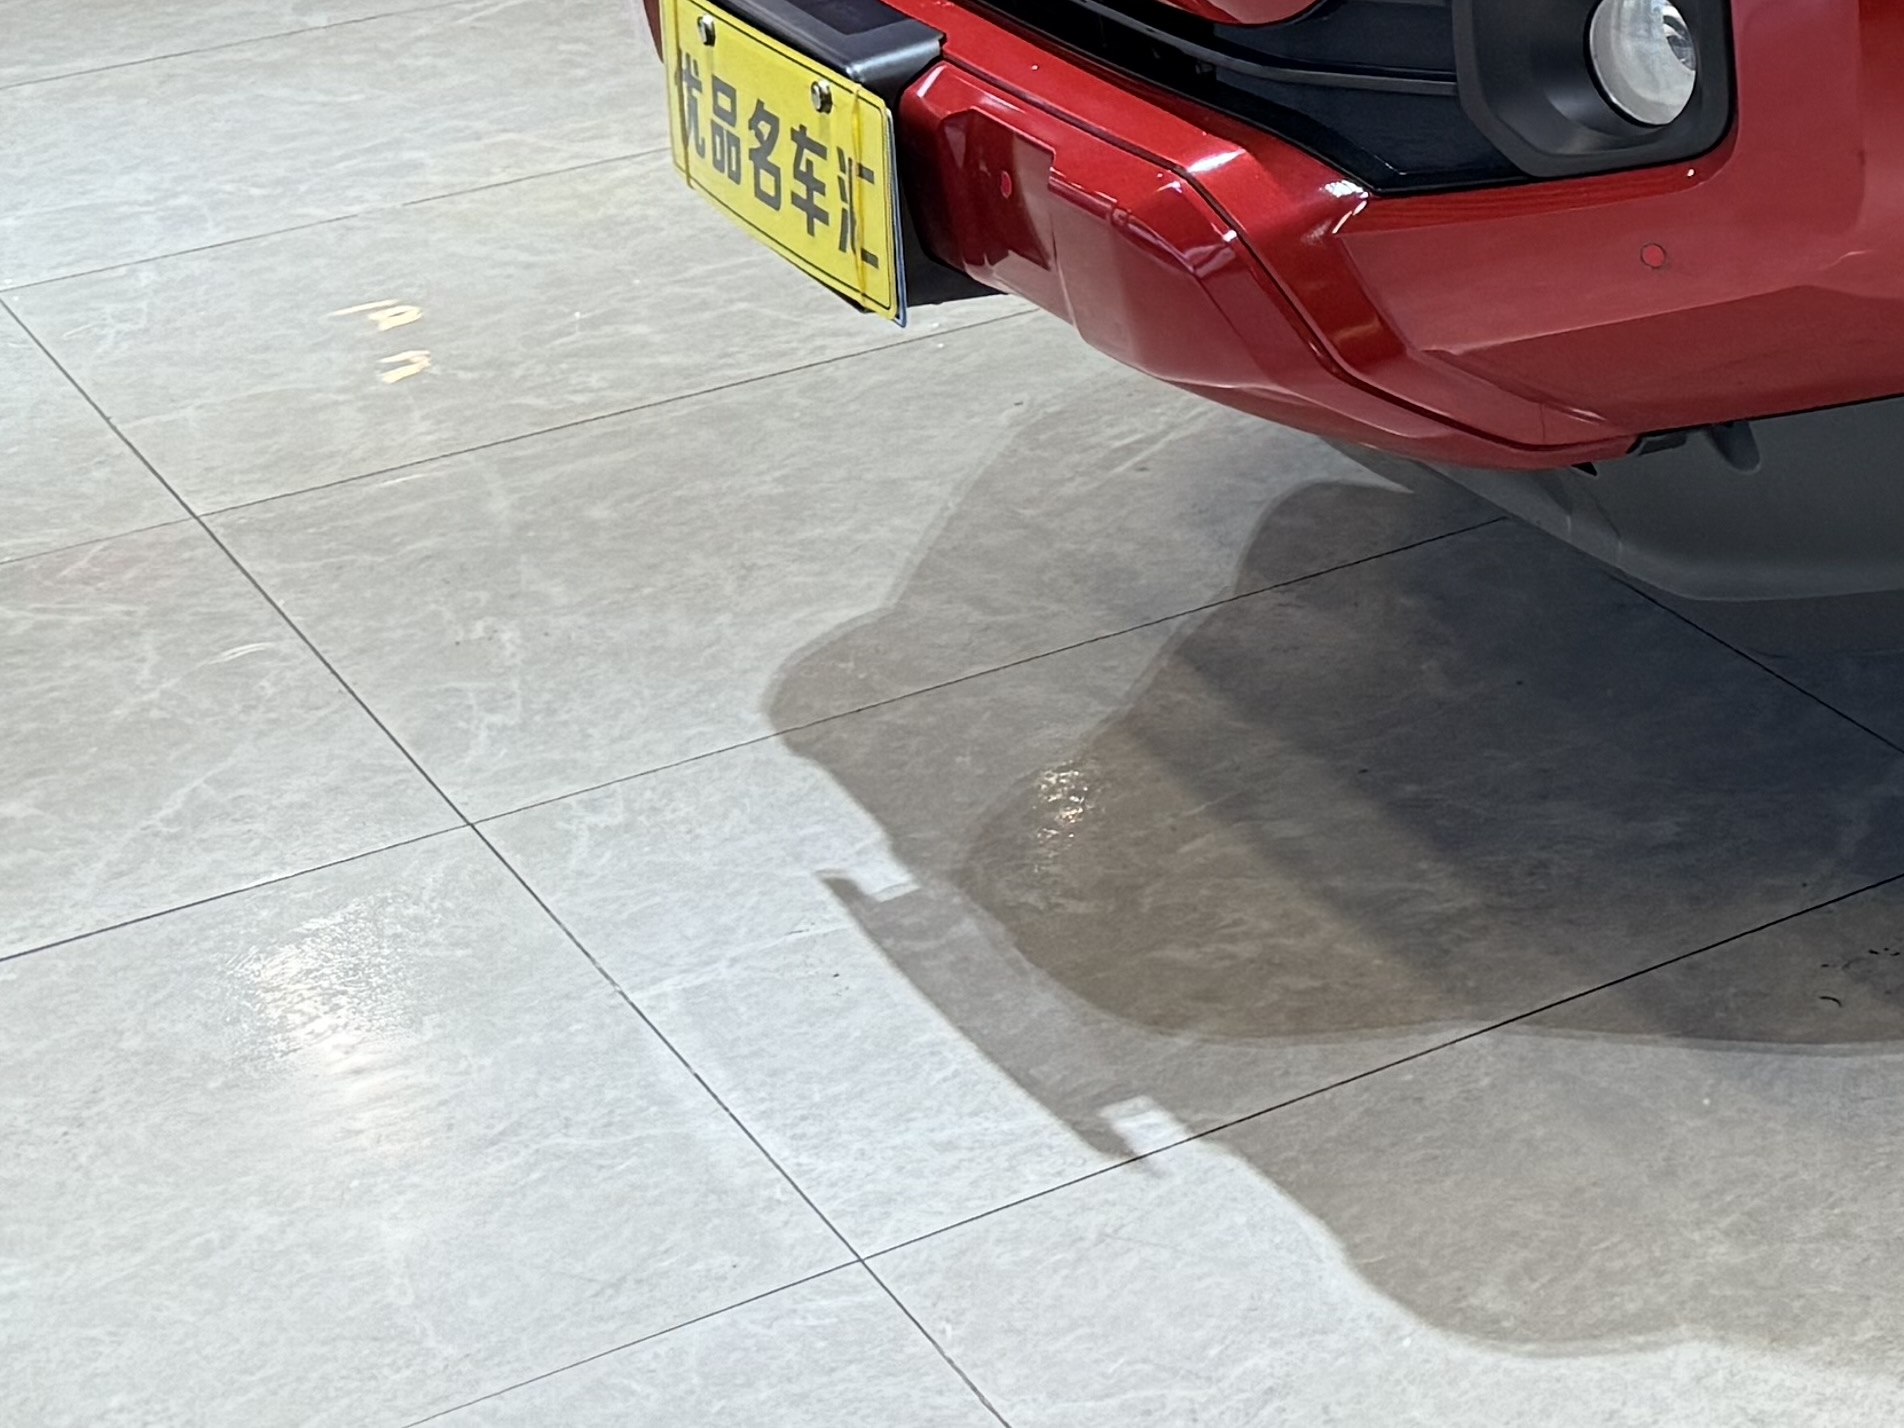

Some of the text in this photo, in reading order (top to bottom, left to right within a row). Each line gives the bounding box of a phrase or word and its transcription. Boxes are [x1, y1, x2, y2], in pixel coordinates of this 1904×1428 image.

[674, 50, 880, 270] 优品名车汇
